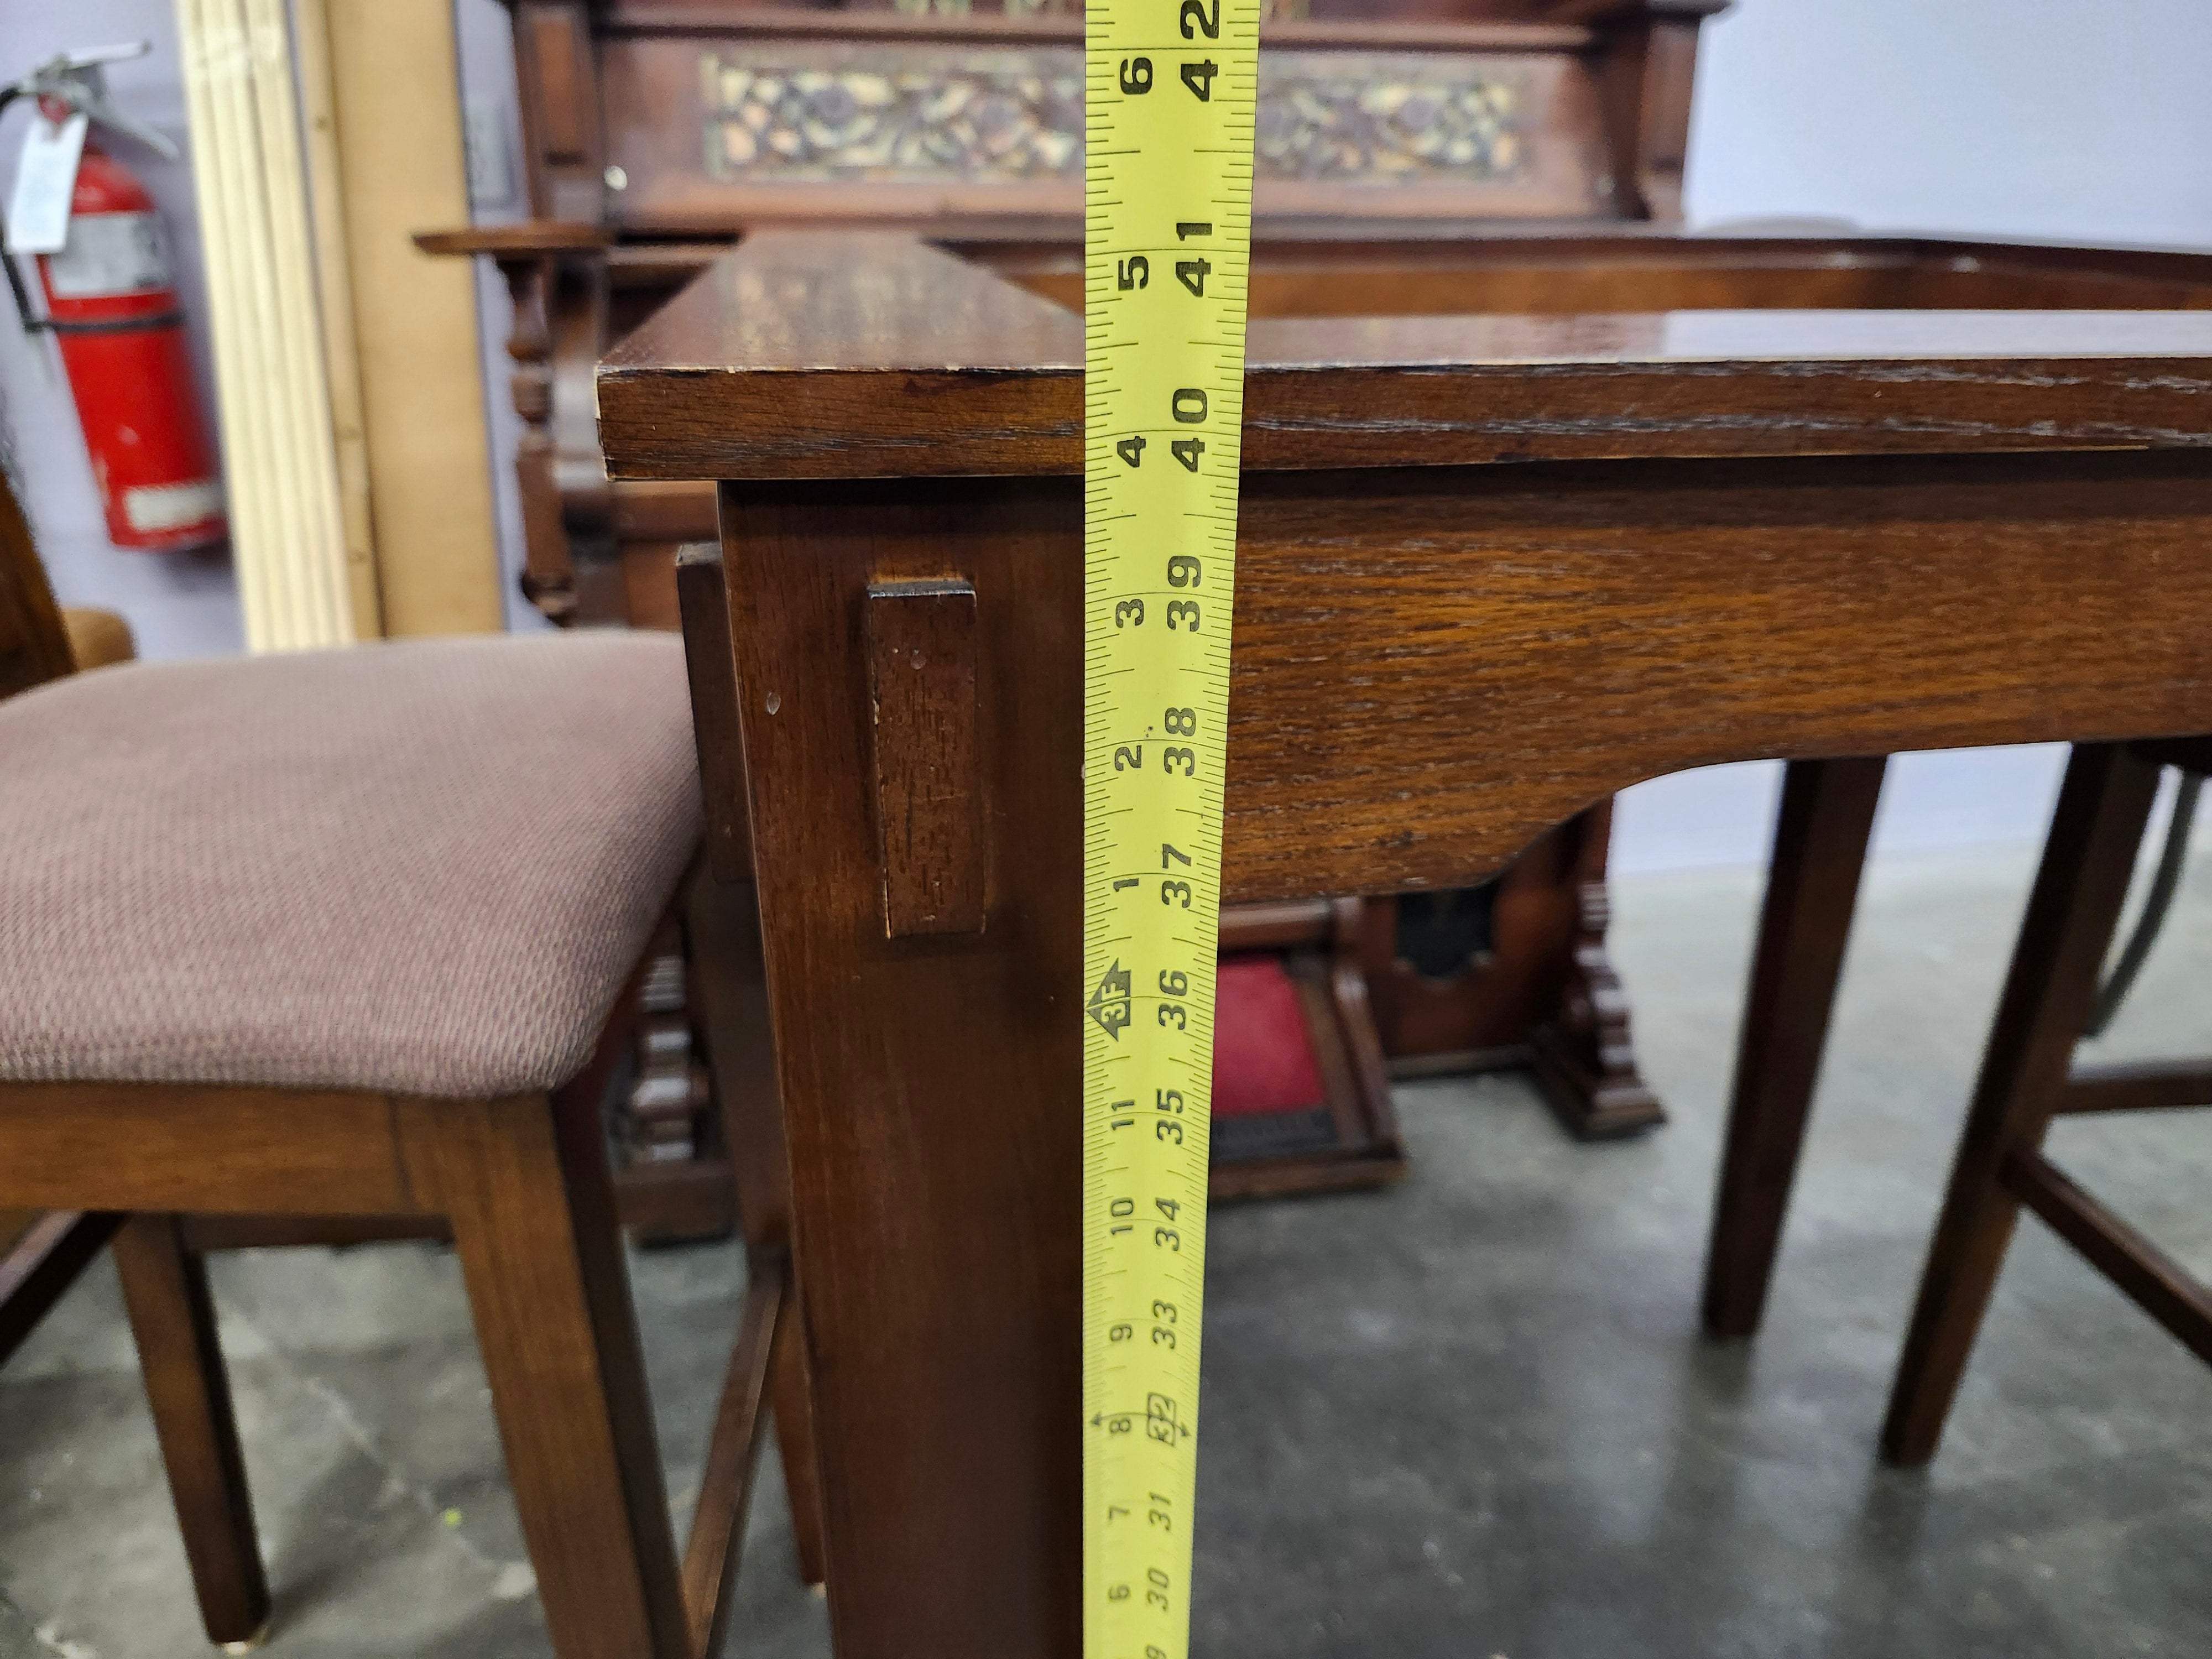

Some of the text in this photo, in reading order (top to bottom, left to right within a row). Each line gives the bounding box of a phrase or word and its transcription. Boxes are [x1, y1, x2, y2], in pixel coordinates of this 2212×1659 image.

[1180, 0, 1219, 102] 42
[1119, 57, 1153, 95] 6
[1118, 255, 1149, 291] 5
[1176, 222, 1213, 298] 41
[1172, 388, 1208, 473] 40
[1117, 435, 1146, 468] 4
[1115, 598, 1144, 628] 3
[1167, 555, 1201, 632] 39
[1114, 744, 1142, 771] 2
[1164, 707, 1196, 776] 38
[1113, 878, 1139, 893] 1
[1161, 843, 1192, 908] 37
[1159, 969, 1188, 1030] 36
[1111, 1099, 1135, 1131] 11
[1156, 1088, 1183, 1145] 35
[1110, 1197, 1134, 1235] 10
[1155, 1197, 1181, 1251] 34
[1109, 1324, 1133, 1342] 9
[1152, 1300, 1177, 1349] 33
[1109, 1418, 1131, 1434] 8
[1108, 1505, 1130, 1525] 7
[1149, 1491, 1172, 1532] 31
[1146, 1567, 1169, 1611] 30
